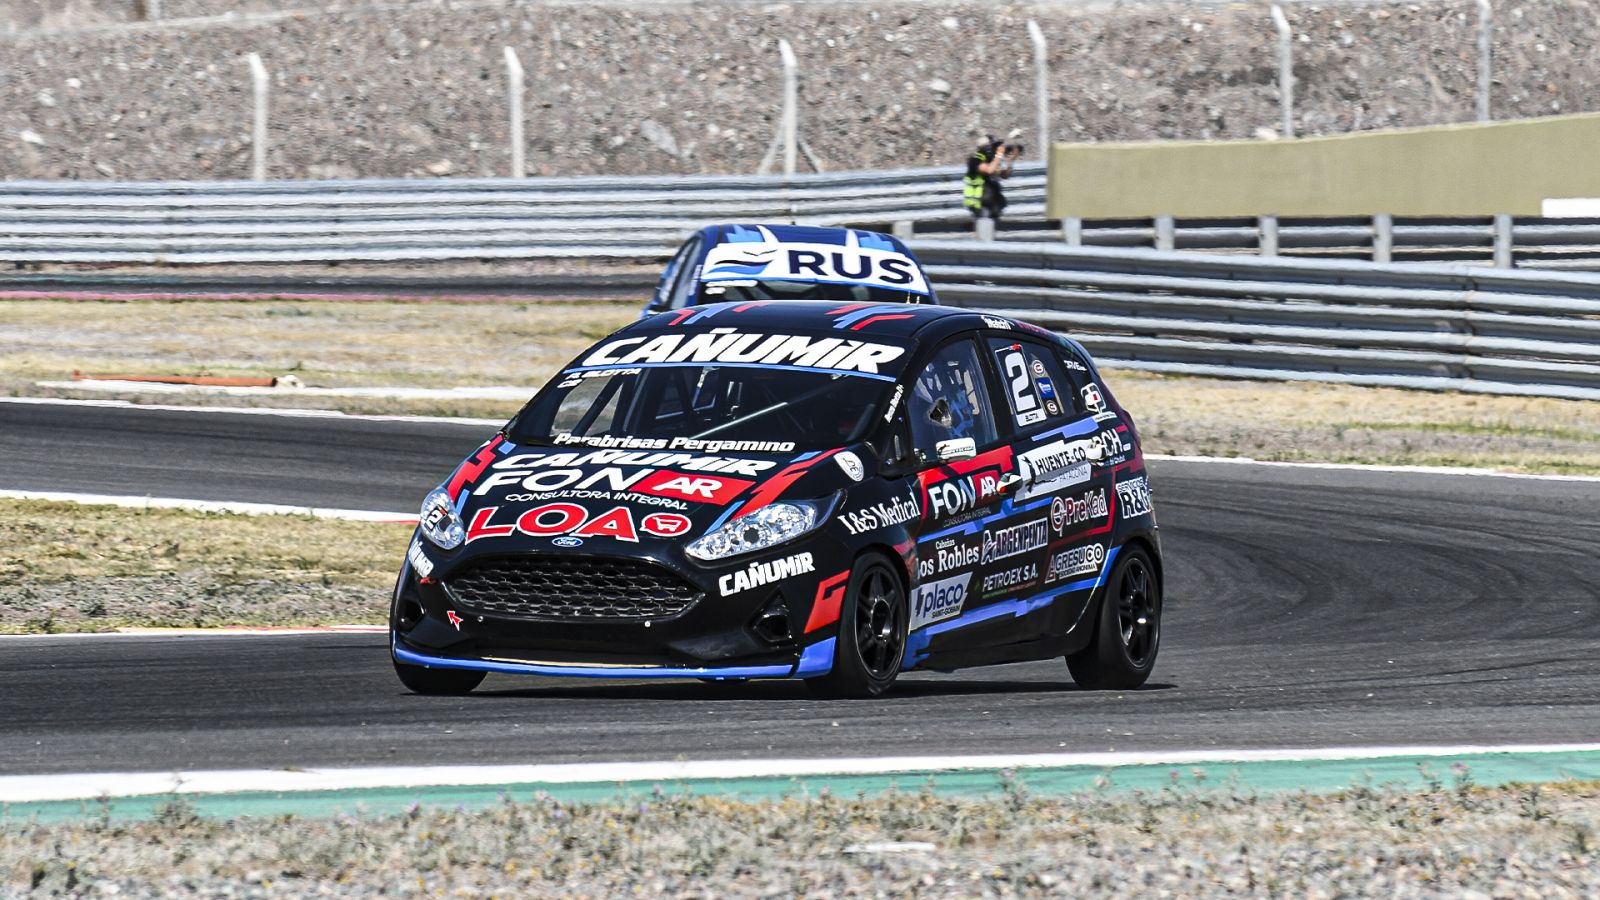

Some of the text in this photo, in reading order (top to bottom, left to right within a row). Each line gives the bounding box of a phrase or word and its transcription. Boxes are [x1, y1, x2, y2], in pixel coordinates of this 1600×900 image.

[788, 249, 914, 284] RUS
[1004, 352, 1036, 412] 2
[553, 432, 796, 453] Parabrisas Pergamino
[473, 467, 723, 498] FON AR
[505, 490, 688, 510] CONSULTORA INTEGRAL
[928, 475, 976, 520] FON
[464, 502, 640, 546] LOA
[869, 491, 921, 528] Medical
[994, 519, 1048, 560] ARGENPENTA
[937, 544, 980, 573] Robles
[982, 568, 1022, 593] PETROEX
[1023, 563, 1039, 581] S.A.
[923, 583, 964, 618] placo
